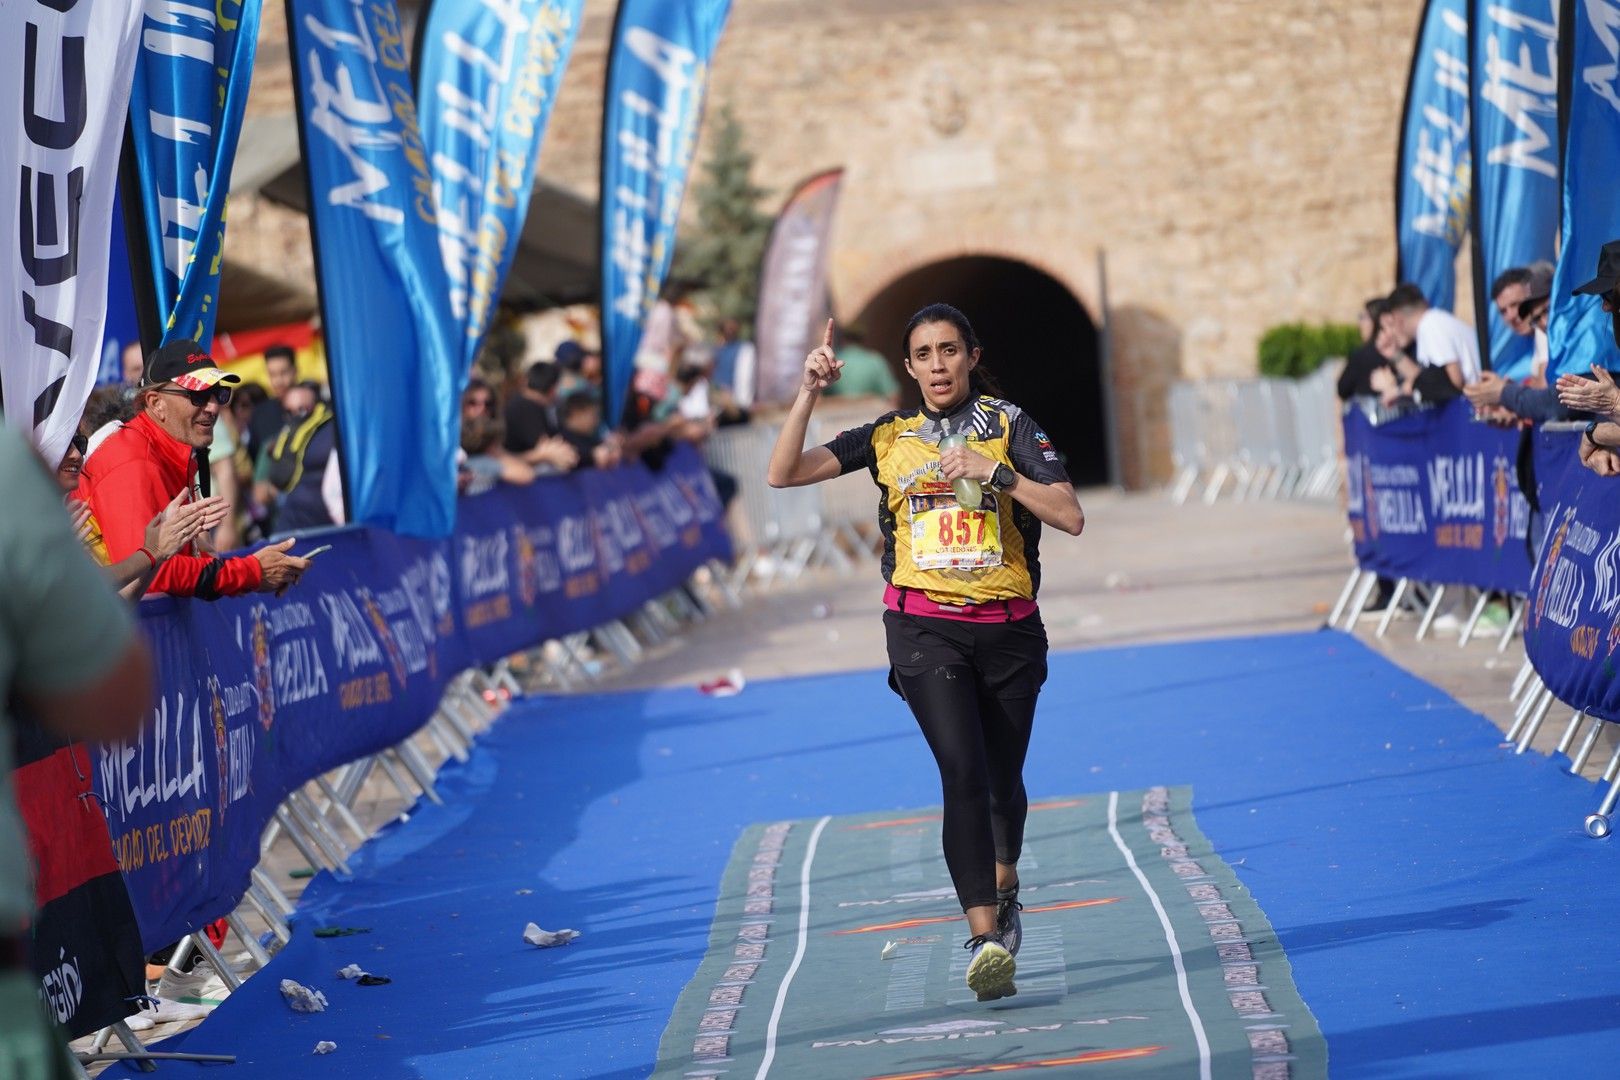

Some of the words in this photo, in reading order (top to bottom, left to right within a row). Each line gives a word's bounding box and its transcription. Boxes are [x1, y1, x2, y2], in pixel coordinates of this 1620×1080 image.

[938, 511, 985, 546] 857
[100, 691, 207, 822] MELILLA
[146, 823, 169, 864] DEL
